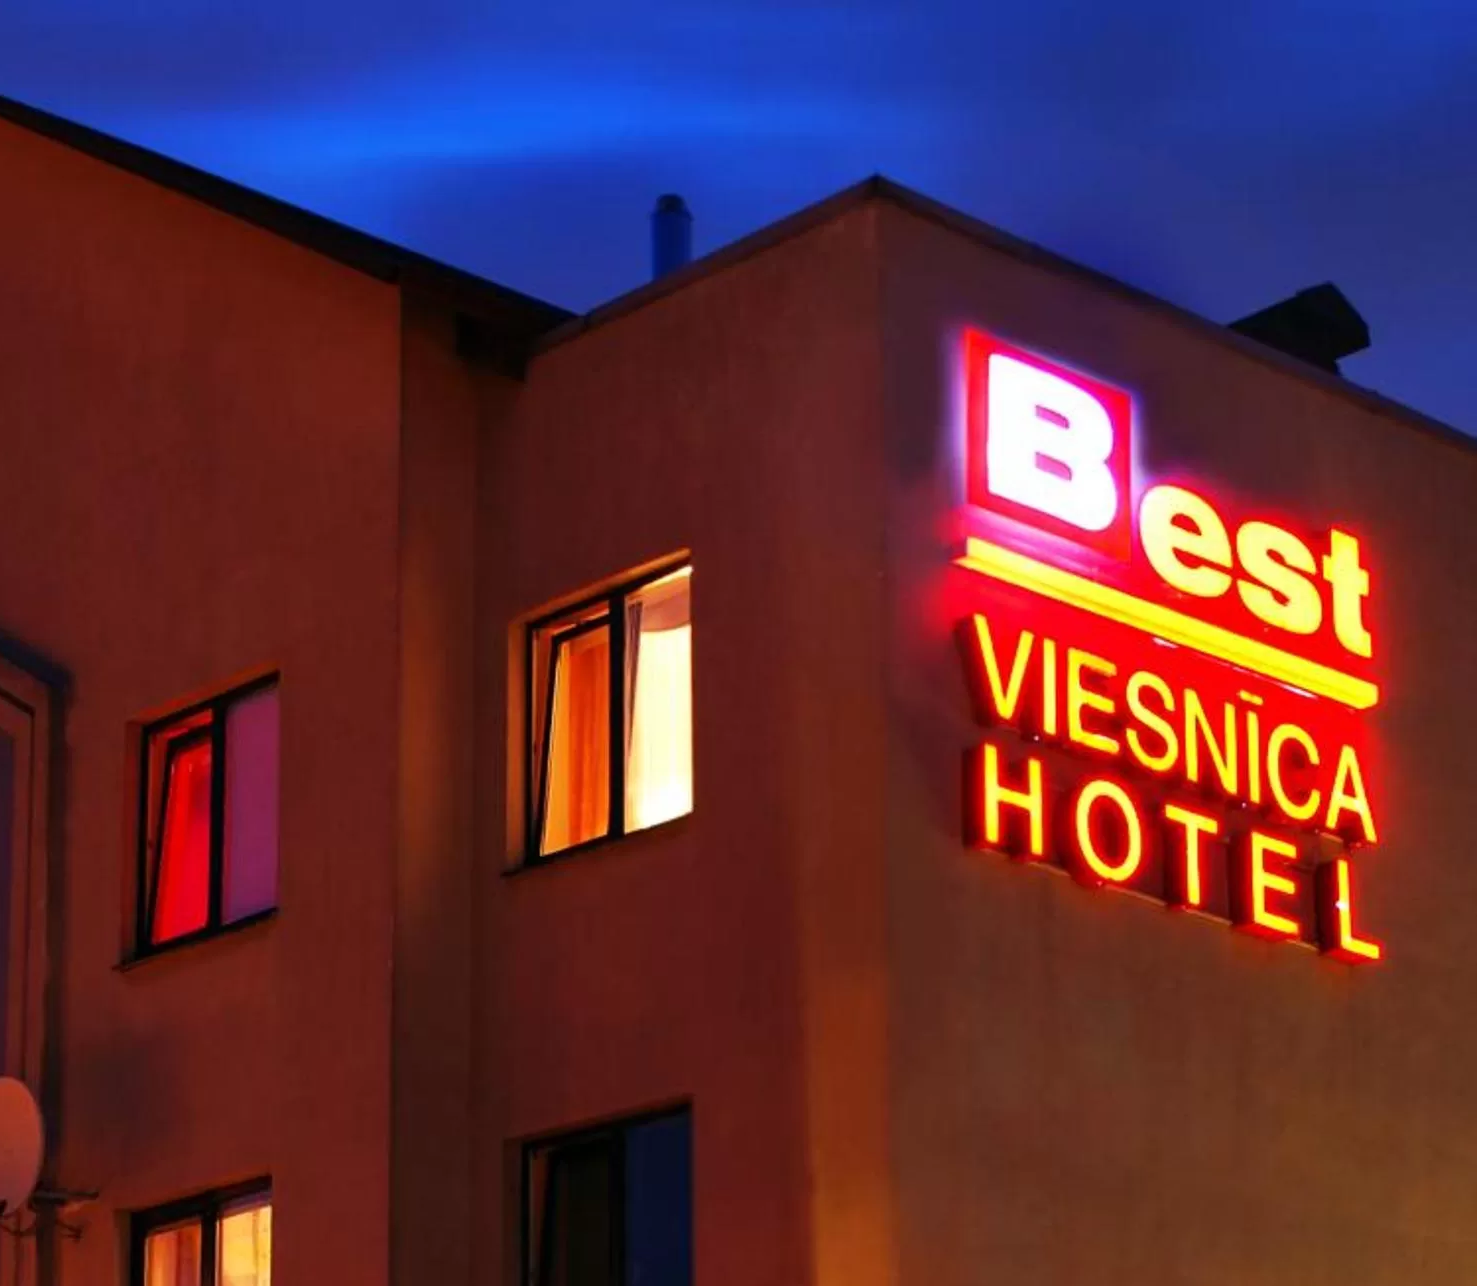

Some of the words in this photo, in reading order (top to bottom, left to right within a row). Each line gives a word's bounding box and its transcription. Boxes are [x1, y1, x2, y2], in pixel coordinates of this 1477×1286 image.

[986, 352, 1373, 659] Best
[972, 612, 1378, 844] VIESNĪCA
[983, 742, 1381, 961] HOTEL
